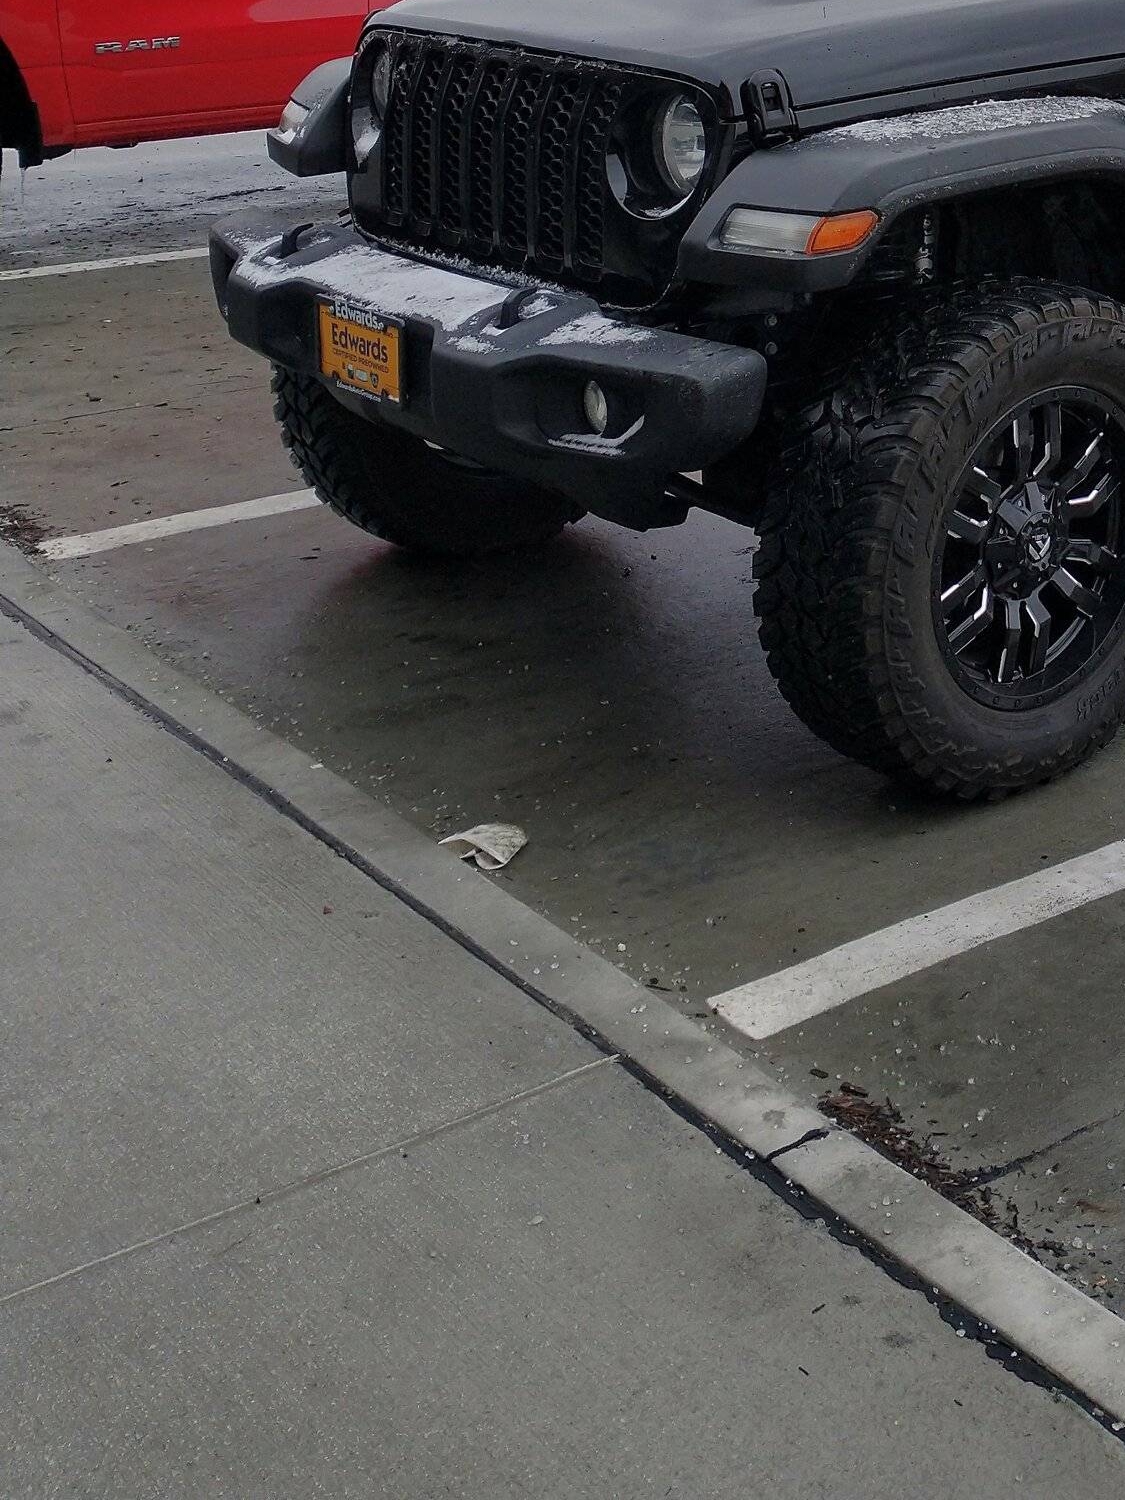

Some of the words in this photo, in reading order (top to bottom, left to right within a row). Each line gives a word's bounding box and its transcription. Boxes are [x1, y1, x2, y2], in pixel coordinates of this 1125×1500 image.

[95, 36, 180, 54] RAM
[334, 299, 380, 329] Edwards
[331, 322, 389, 364] Edwards
